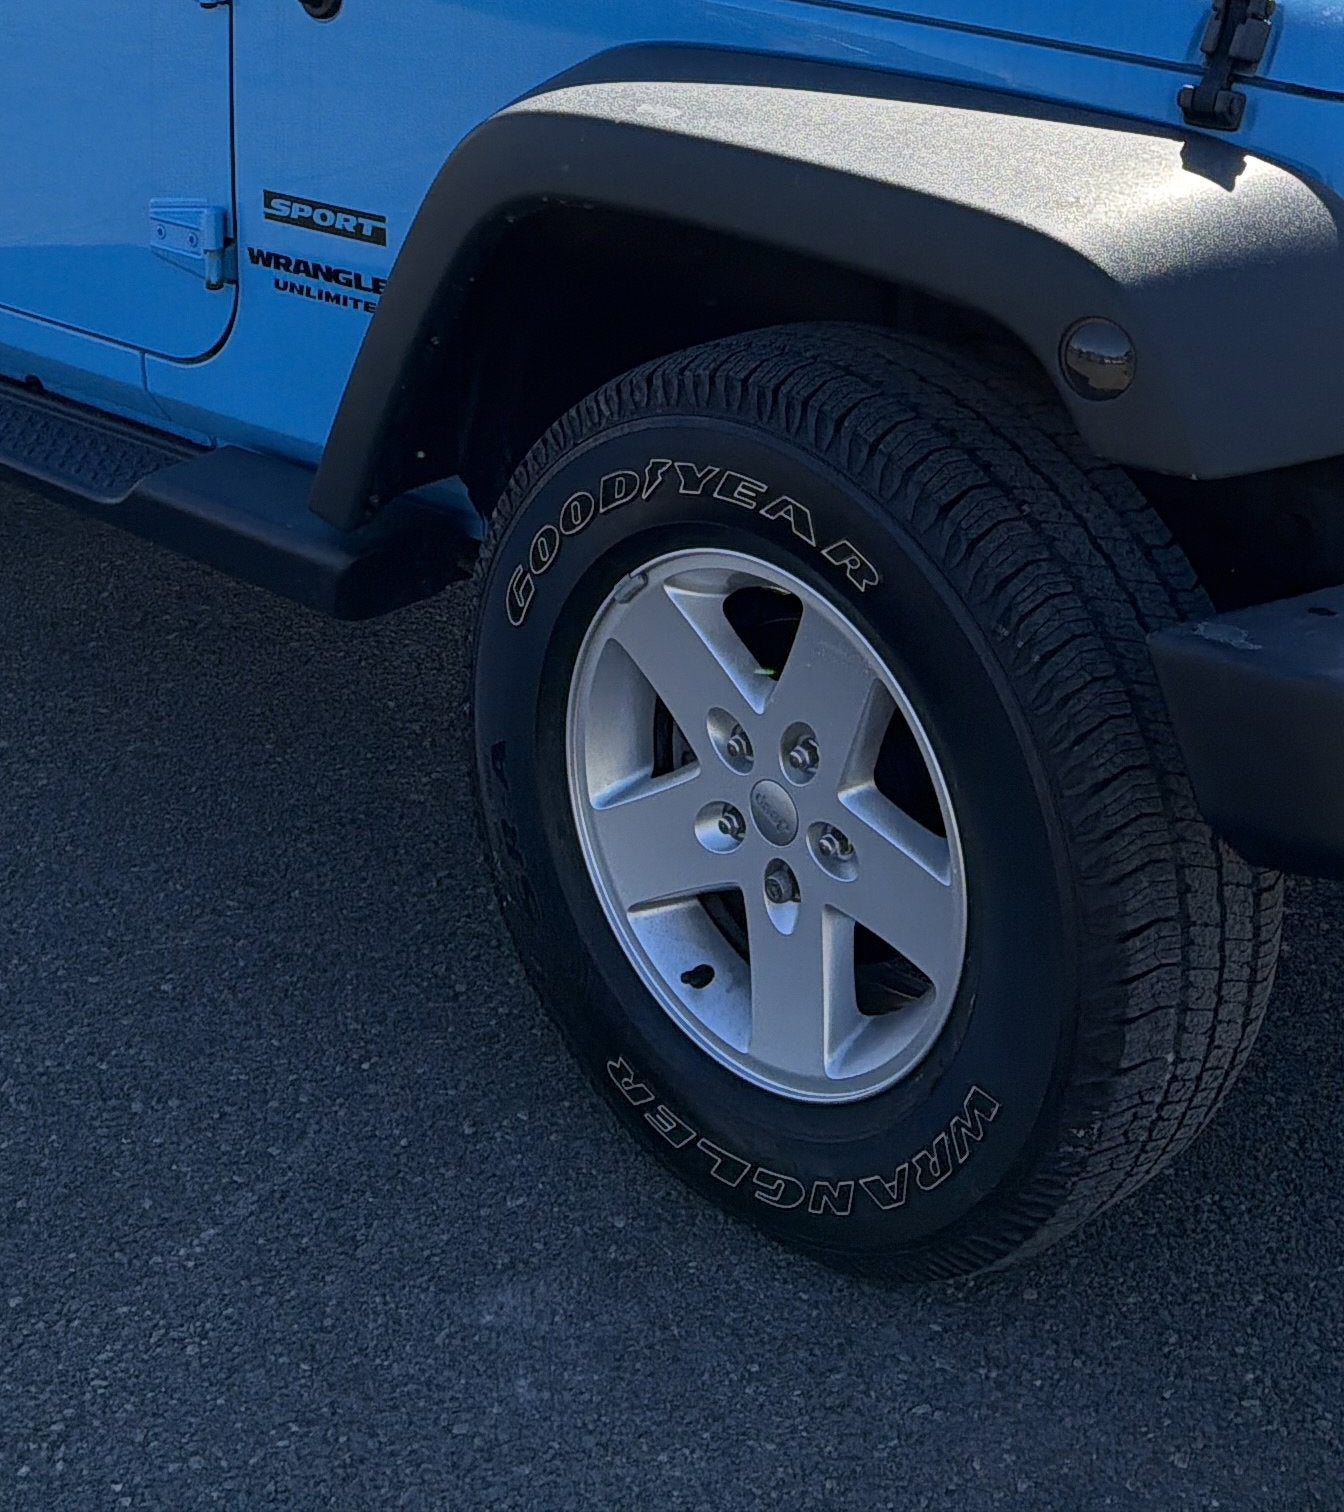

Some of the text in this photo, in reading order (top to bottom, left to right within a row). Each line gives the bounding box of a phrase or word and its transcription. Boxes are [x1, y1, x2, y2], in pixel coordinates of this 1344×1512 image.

[264, 198, 386, 236] SPORT
[247, 246, 387, 295] WRANGLE
[274, 278, 377, 314] UNLIMITE
[506, 459, 879, 626] GOODYEAR
[606, 1056, 1001, 1216] WRANGLER
